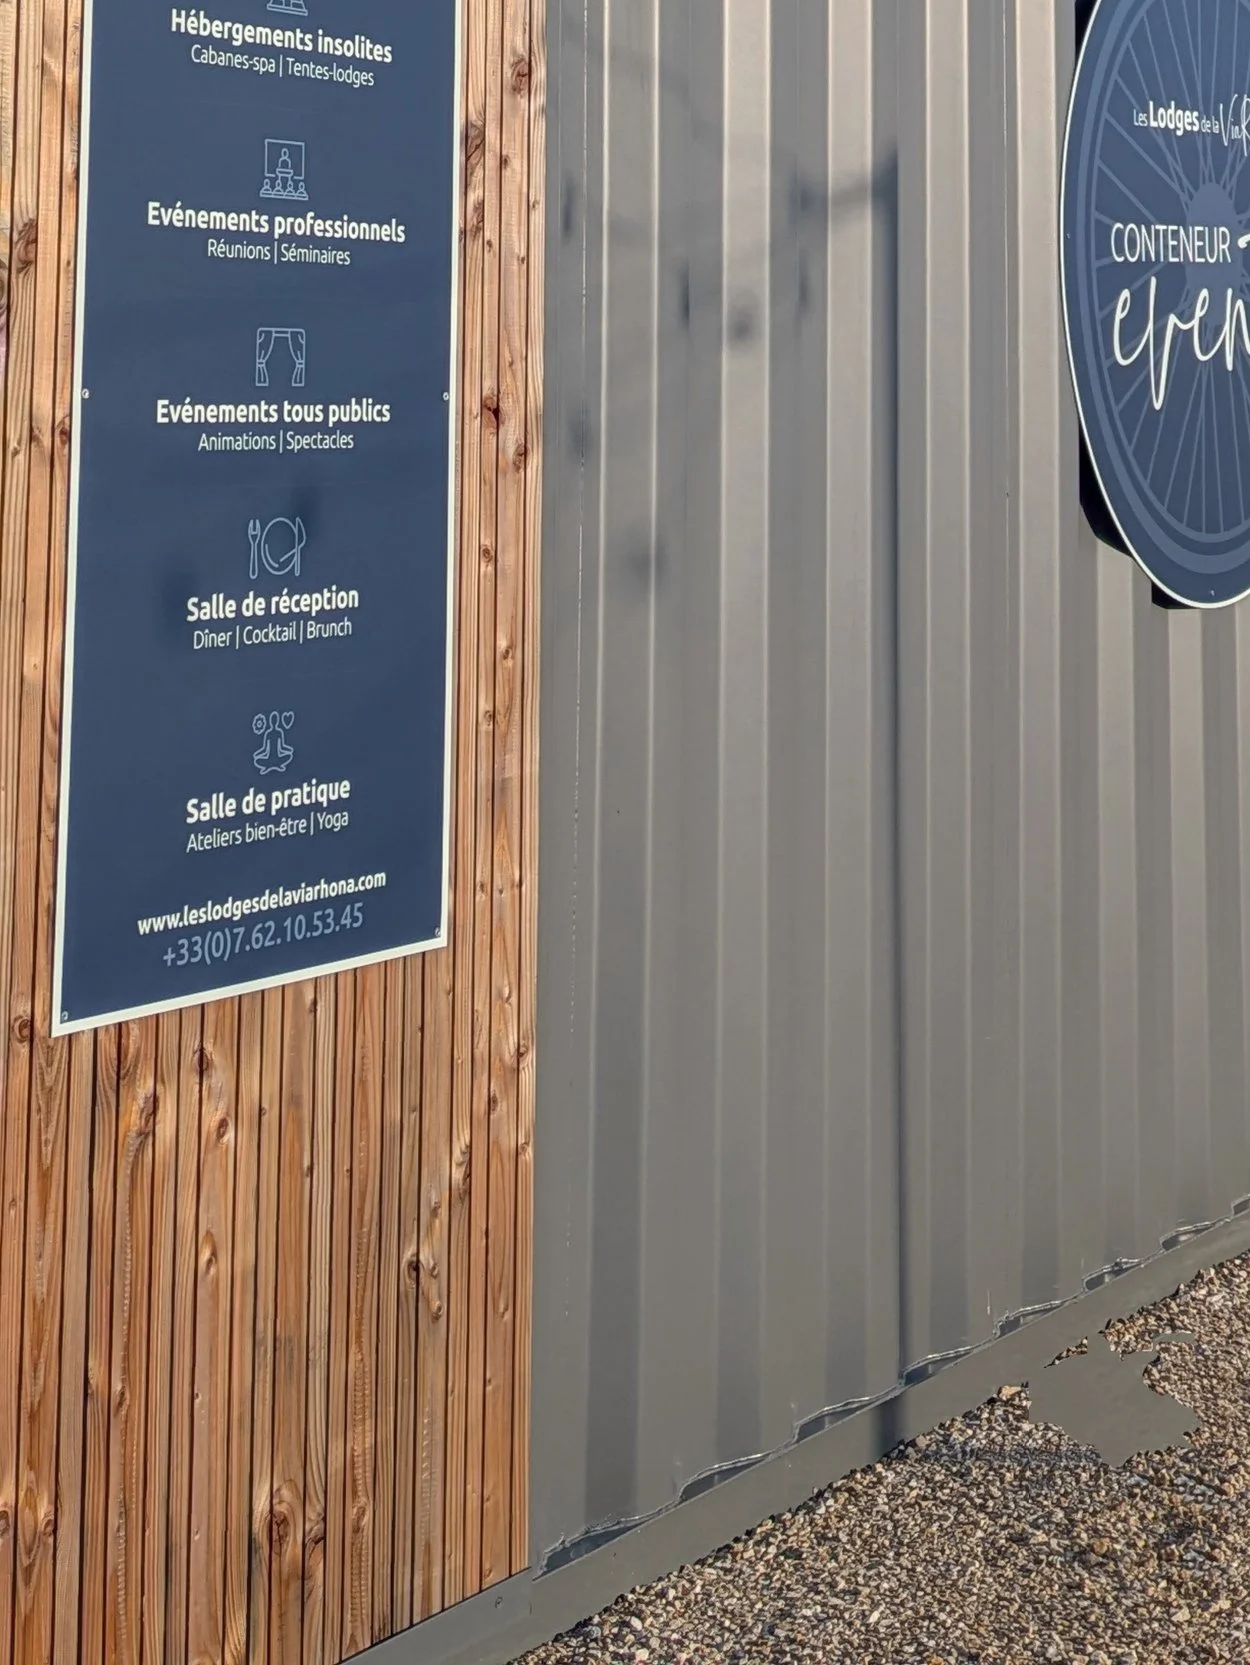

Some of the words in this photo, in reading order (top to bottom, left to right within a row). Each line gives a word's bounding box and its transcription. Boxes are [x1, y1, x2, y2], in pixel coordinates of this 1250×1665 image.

[171, 8, 312, 51] Hébergements
[318, 29, 392, 63] insolites
[191, 44, 275, 73] Cabanes-spa
[287, 57, 374, 87] Tentes-lodges
[1133, 109, 1148, 127] Les
[1149, 100, 1199, 136] Lodges
[1201, 116, 1211, 133] de
[1212, 116, 1220, 134] la
[147, 201, 269, 234] Evénements
[274, 211, 406, 243] professionnels
[1111, 222, 1231, 264] CONTENEUR
[207, 239, 271, 260] Réunions
[281, 242, 351, 265] Séminaires
[156, 397, 278, 424] Evénements
[283, 401, 324, 423] tous
[329, 398, 391, 426] publics
[198, 432, 276, 452] Animations
[286, 429, 354, 453] Spectacles
[186, 593, 236, 622] Salle
[242, 591, 265, 616] de
[271, 584, 359, 617] réception
[193, 629, 233, 650] Dîner
[242, 621, 297, 645] Cocktail
[307, 617, 352, 639] Brunch
[186, 792, 237, 824] Salle
[242, 787, 266, 815] de
[271, 778, 351, 815] pratique
[186, 827, 242, 853] Ateliers
[245, 817, 307, 843] bien-être
[317, 810, 349, 833] Yoga
[137, 871, 387, 936] www.leslodgesdelaviarhona.com
[163, 902, 364, 967] +33(0)7.62.10.53.45
